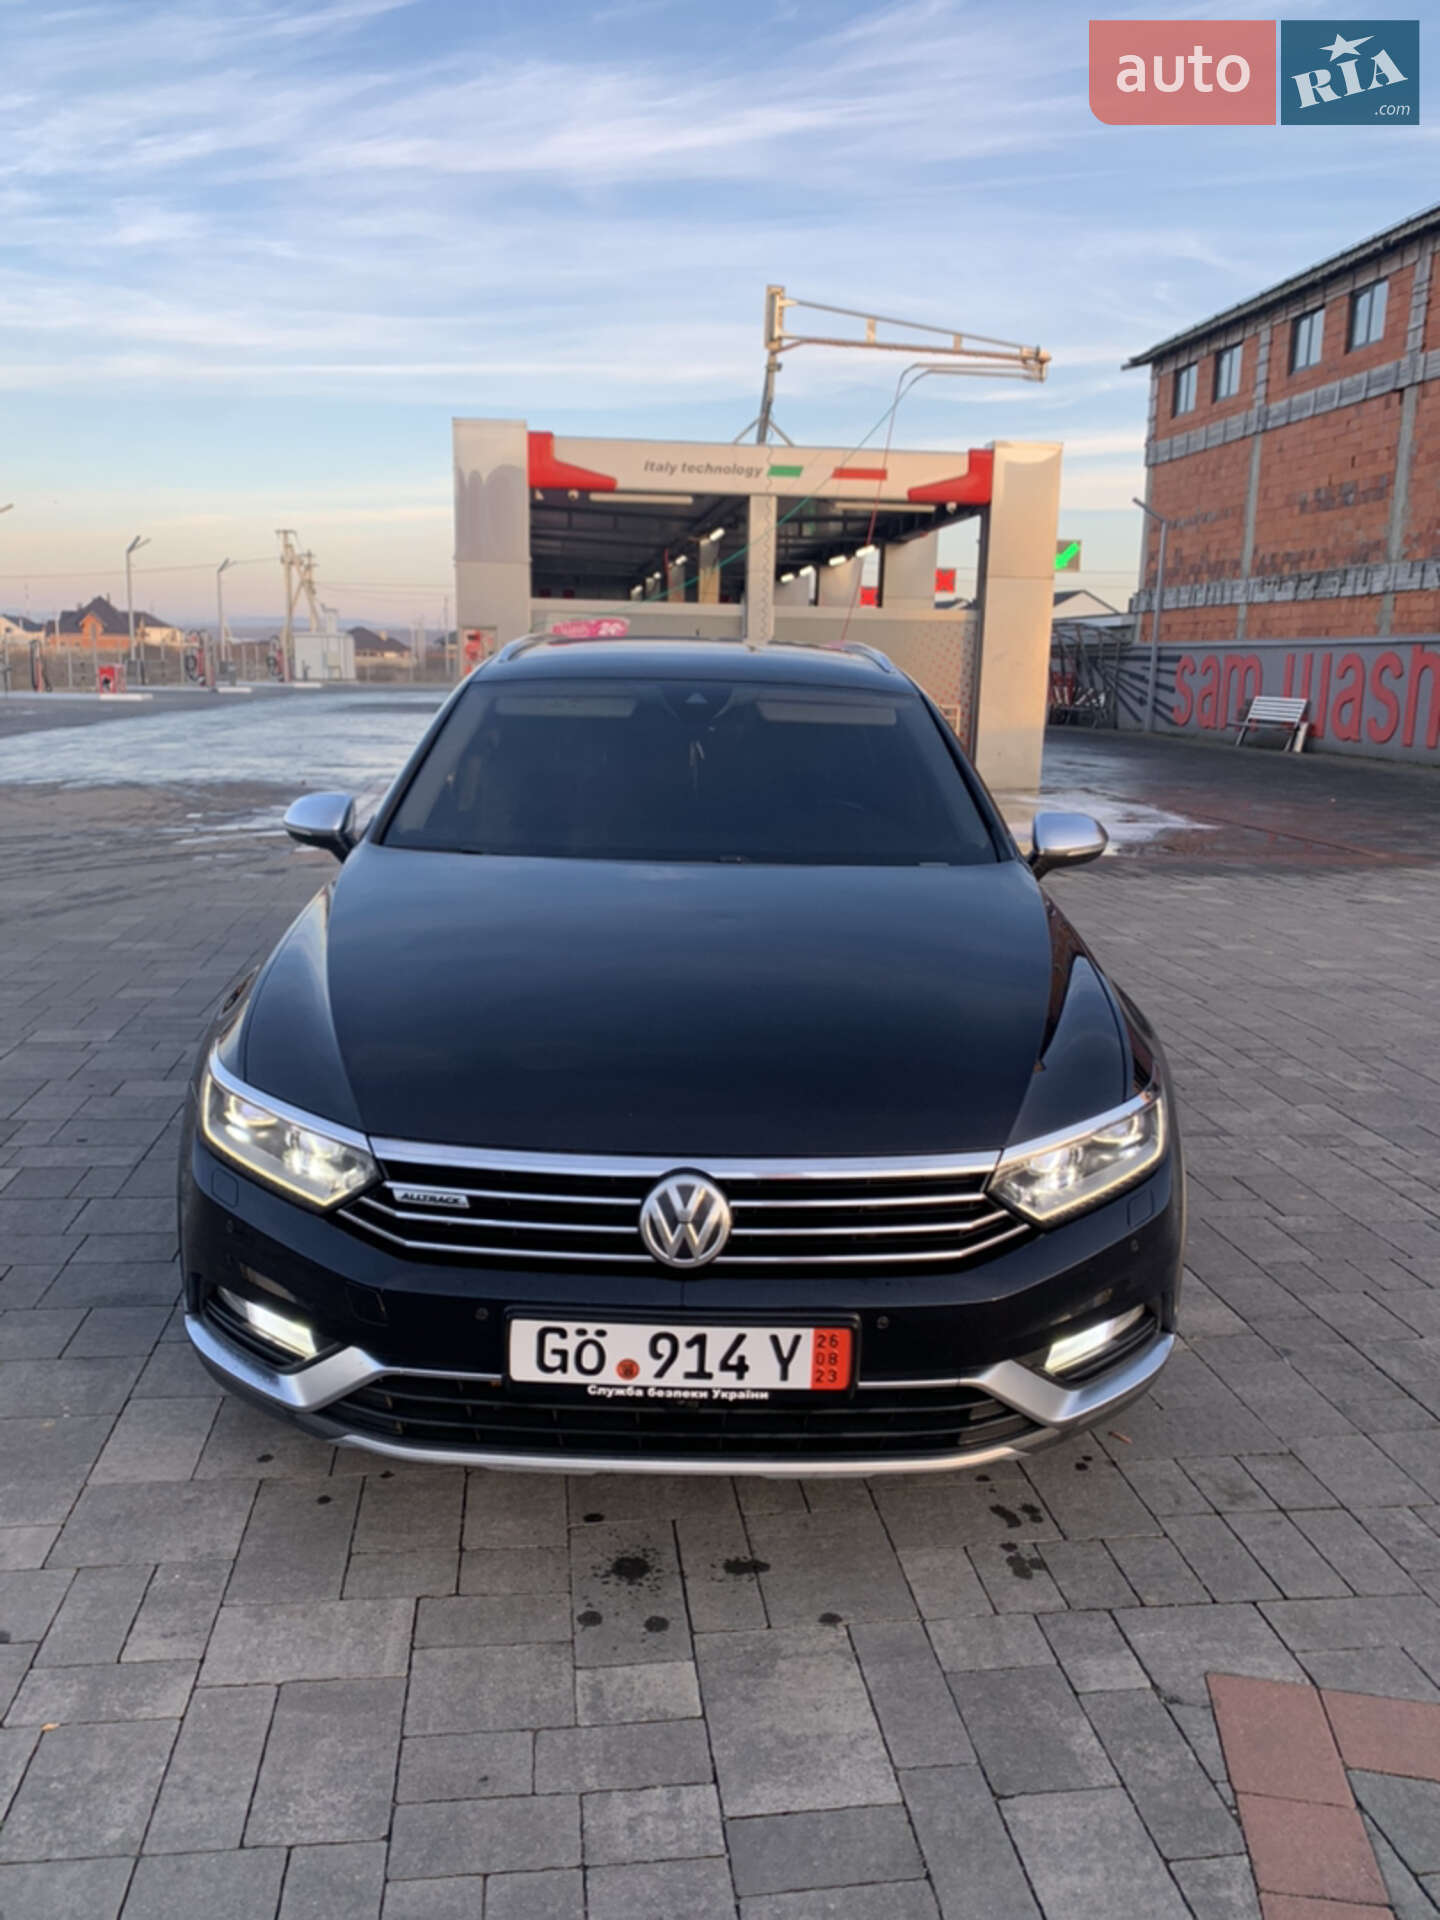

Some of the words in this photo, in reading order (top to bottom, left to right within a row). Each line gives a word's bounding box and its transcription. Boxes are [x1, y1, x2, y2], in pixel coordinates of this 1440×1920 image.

[644, 460, 678, 475] Italy
[681, 463, 763, 478] technology
[1174, 654, 1263, 732] sam
[816, 1333, 839, 1349] 26
[536, 1326, 608, 1376] GÖ
[648, 1331, 750, 1381] 914
[768, 1333, 803, 1382] Y
[815, 1351, 838, 1366] 08
[815, 1368, 838, 1384] 23
[587, 1384, 644, 1398] Служба
[647, 1387, 709, 1399] безпеки
[712, 1388, 770, 1401] України
